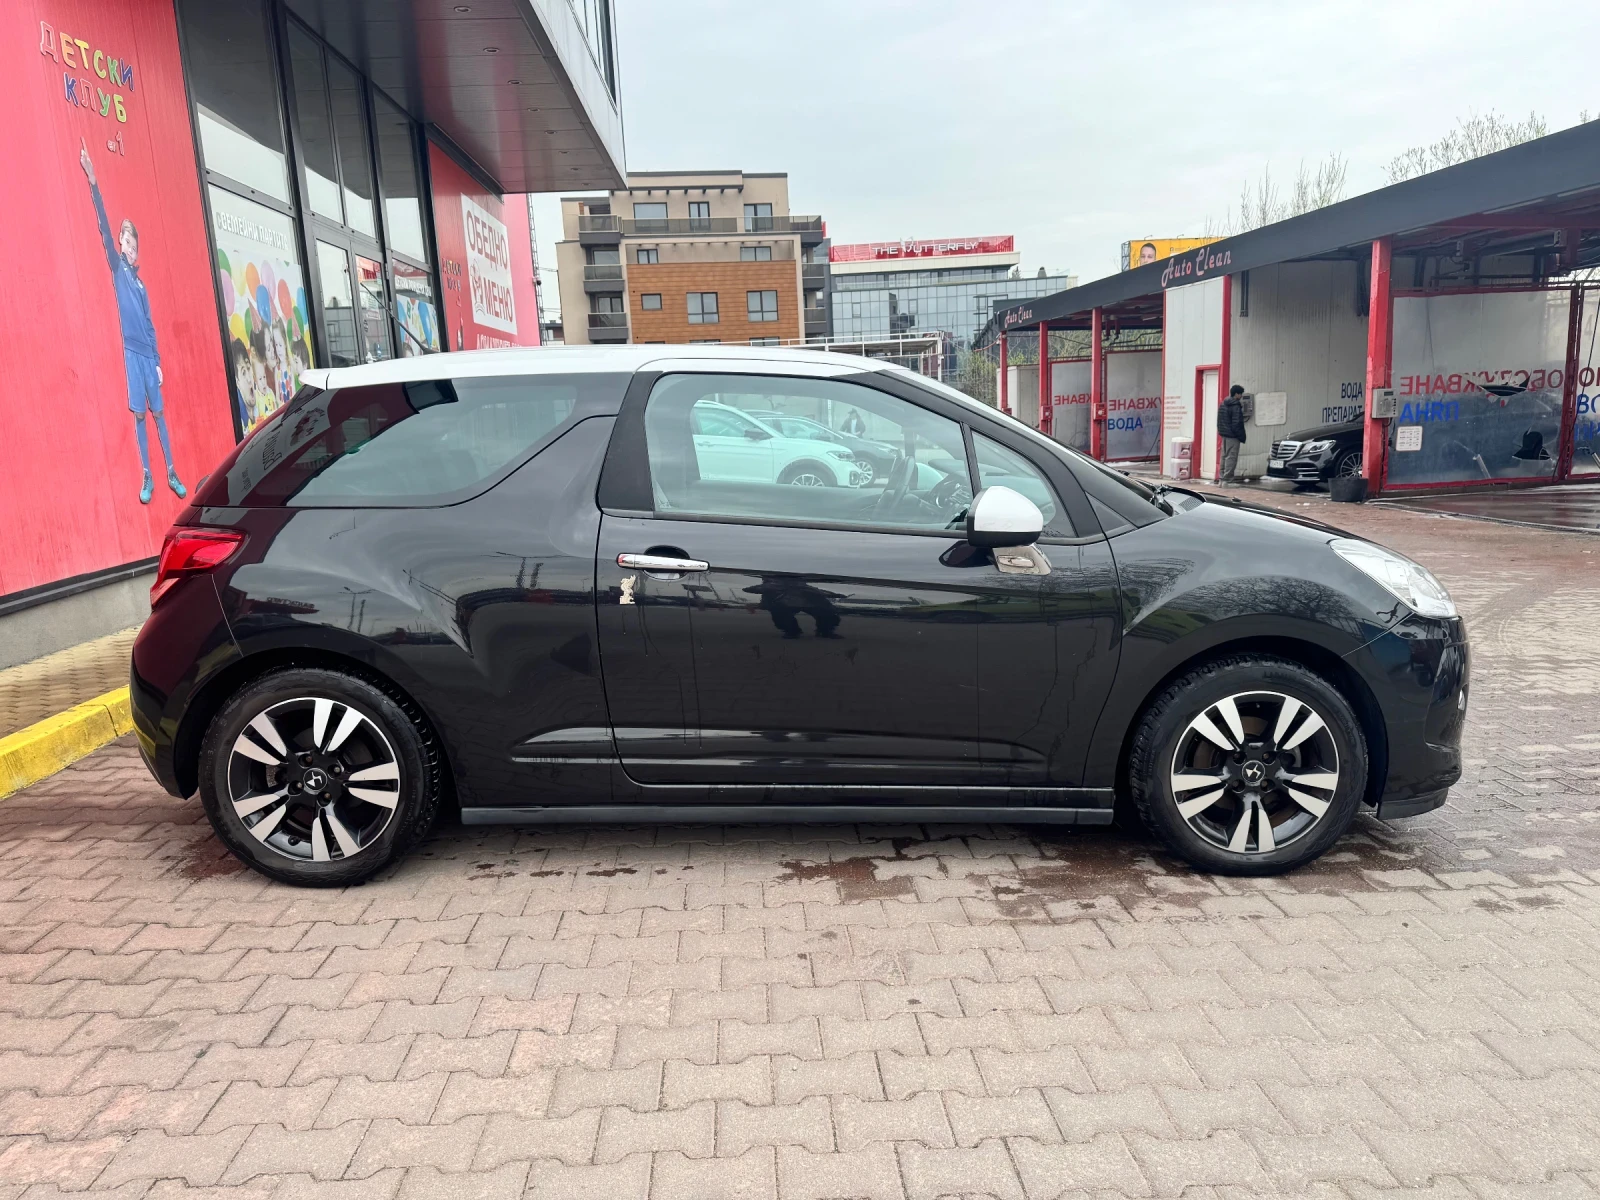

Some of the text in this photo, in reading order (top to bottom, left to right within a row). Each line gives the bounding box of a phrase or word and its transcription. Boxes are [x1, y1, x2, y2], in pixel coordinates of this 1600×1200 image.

[39, 20, 135, 92] ДЕТСКИ
[63, 71, 127, 124] КЛУБ
[466, 209, 508, 271] ОБЕДНО
[872, 245, 898, 255] THE
[1161, 247, 1232, 288] Auto Clean
[482, 276, 513, 323] МЕНЮ
[1341, 381, 1363, 401] ВОДА
[1108, 416, 1143, 431] ВОДА
